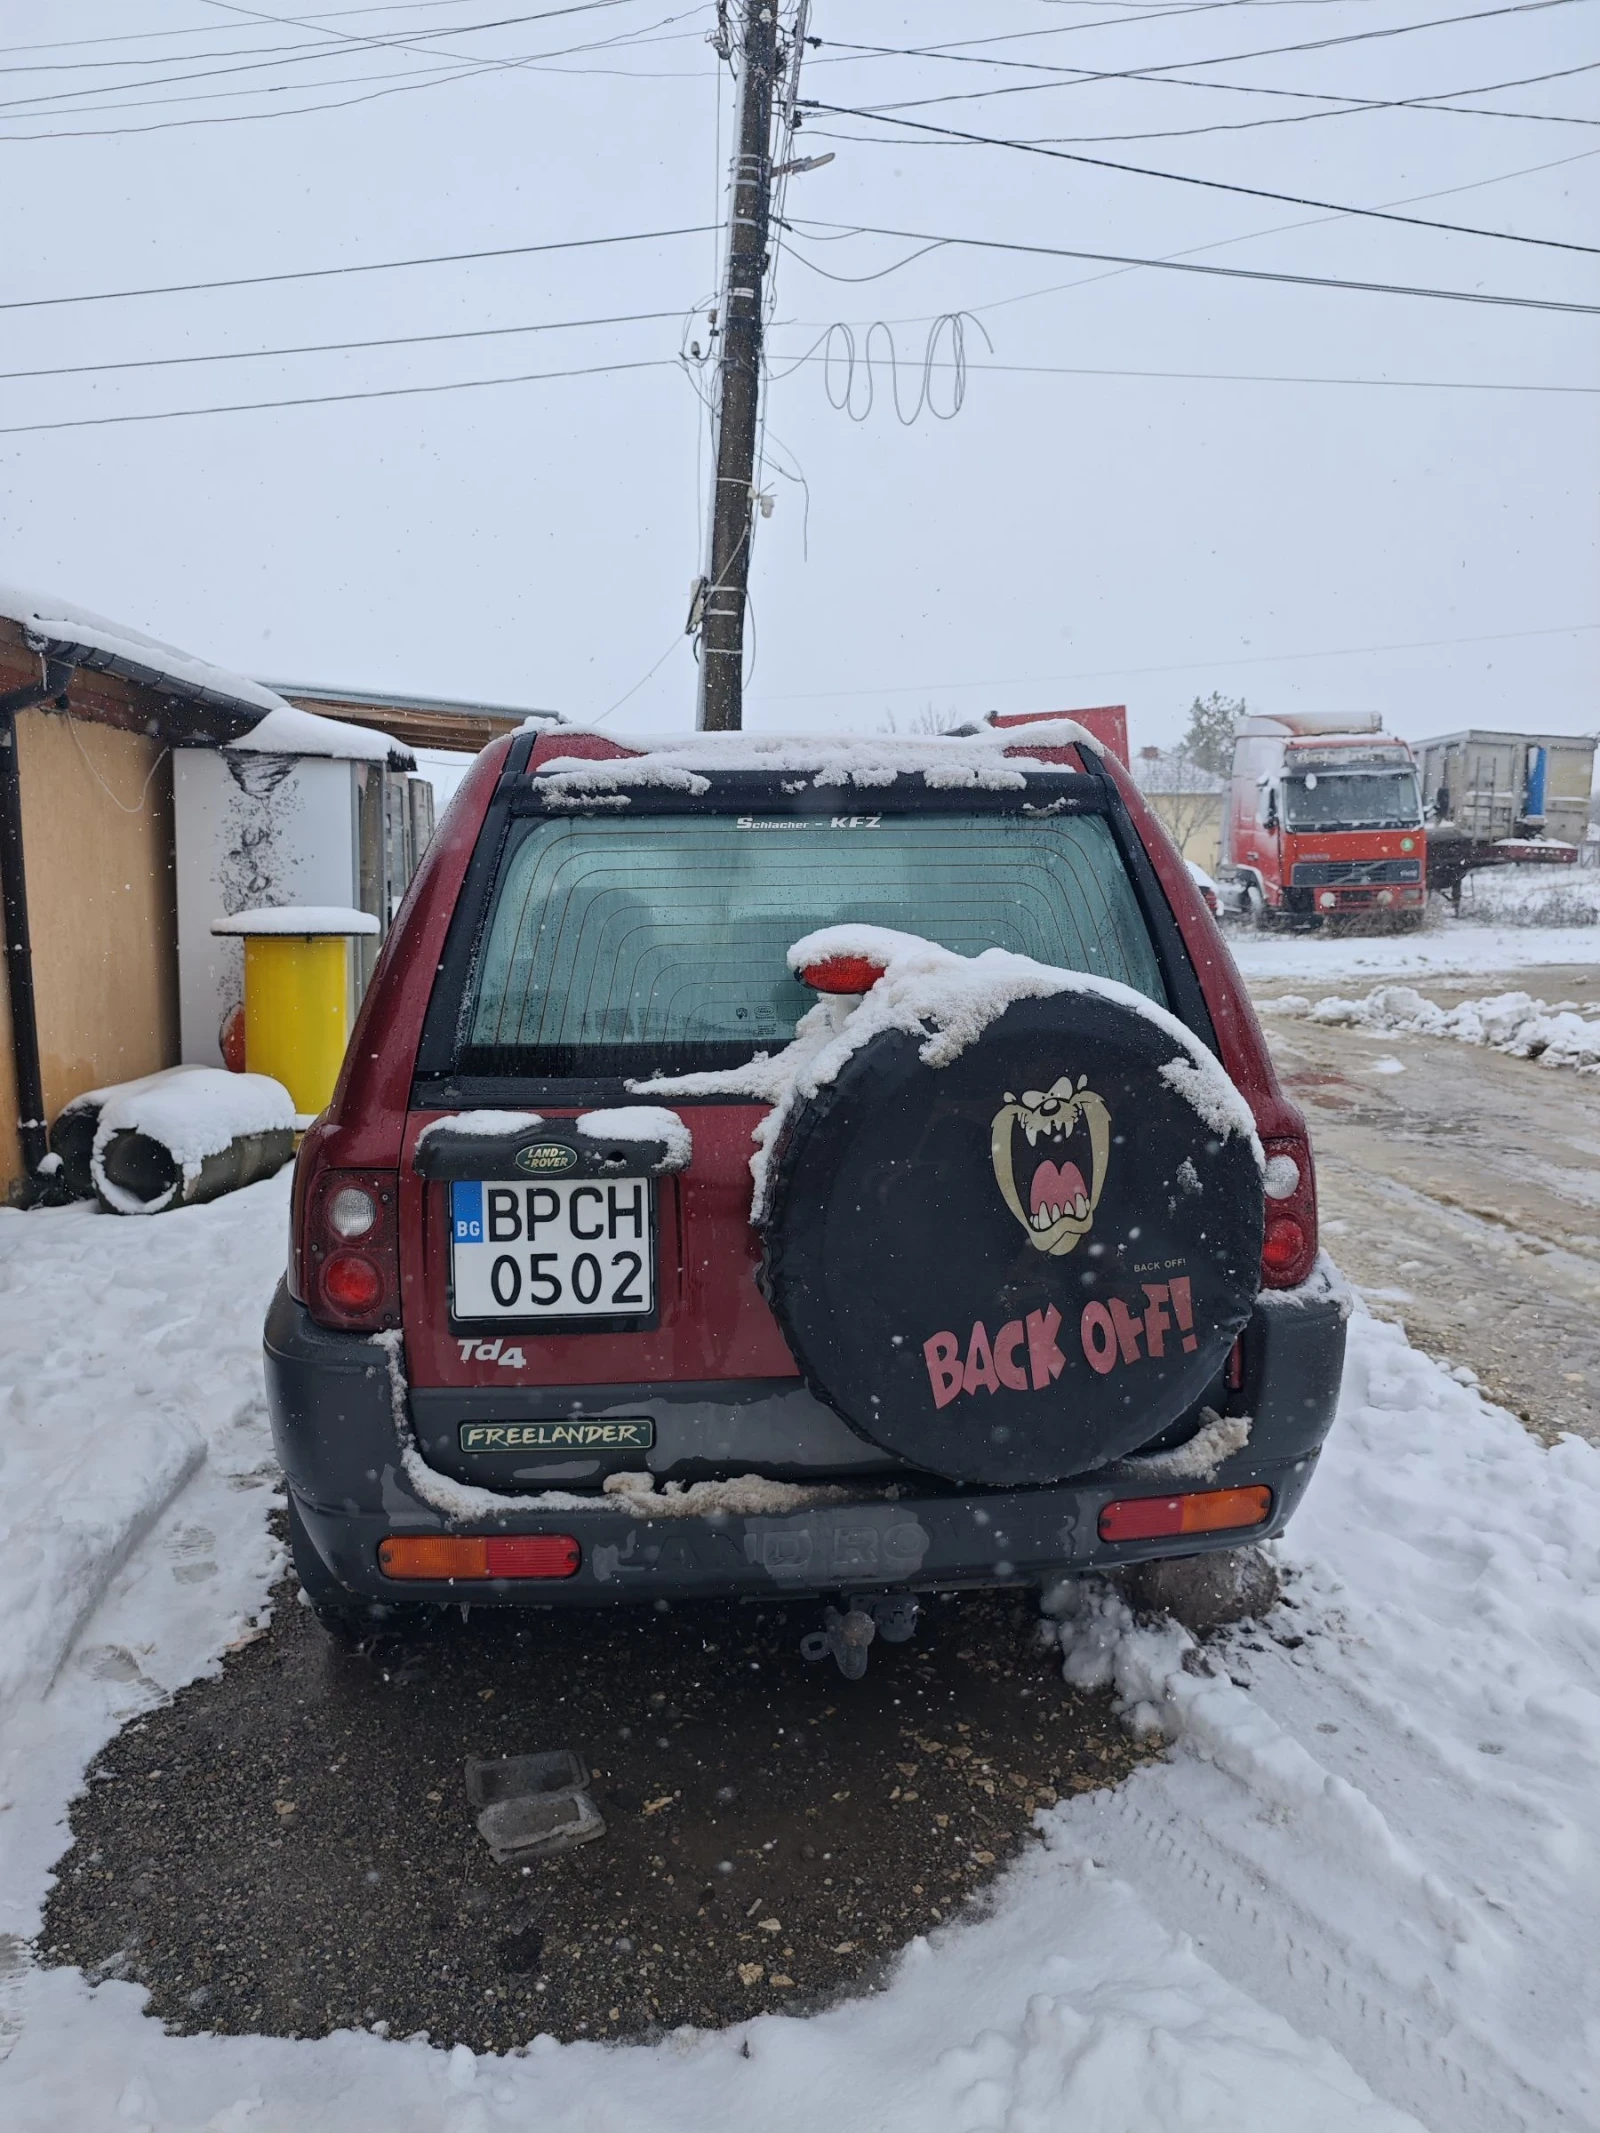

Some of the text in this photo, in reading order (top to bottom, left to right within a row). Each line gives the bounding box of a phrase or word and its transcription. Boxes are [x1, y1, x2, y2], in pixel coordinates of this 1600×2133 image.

[736, 817, 810, 829] Schlacher
[830, 816, 882, 828] KFZ
[457, 1221, 481, 1237] BG
[1133, 1258, 1186, 1273] BACK OFF!
[490, 1250, 644, 1308] 0502
[456, 1339, 527, 1369] Td4
[922, 1275, 1198, 1410] BACK OFF!
[467, 1424, 642, 1447] FREELANDER
